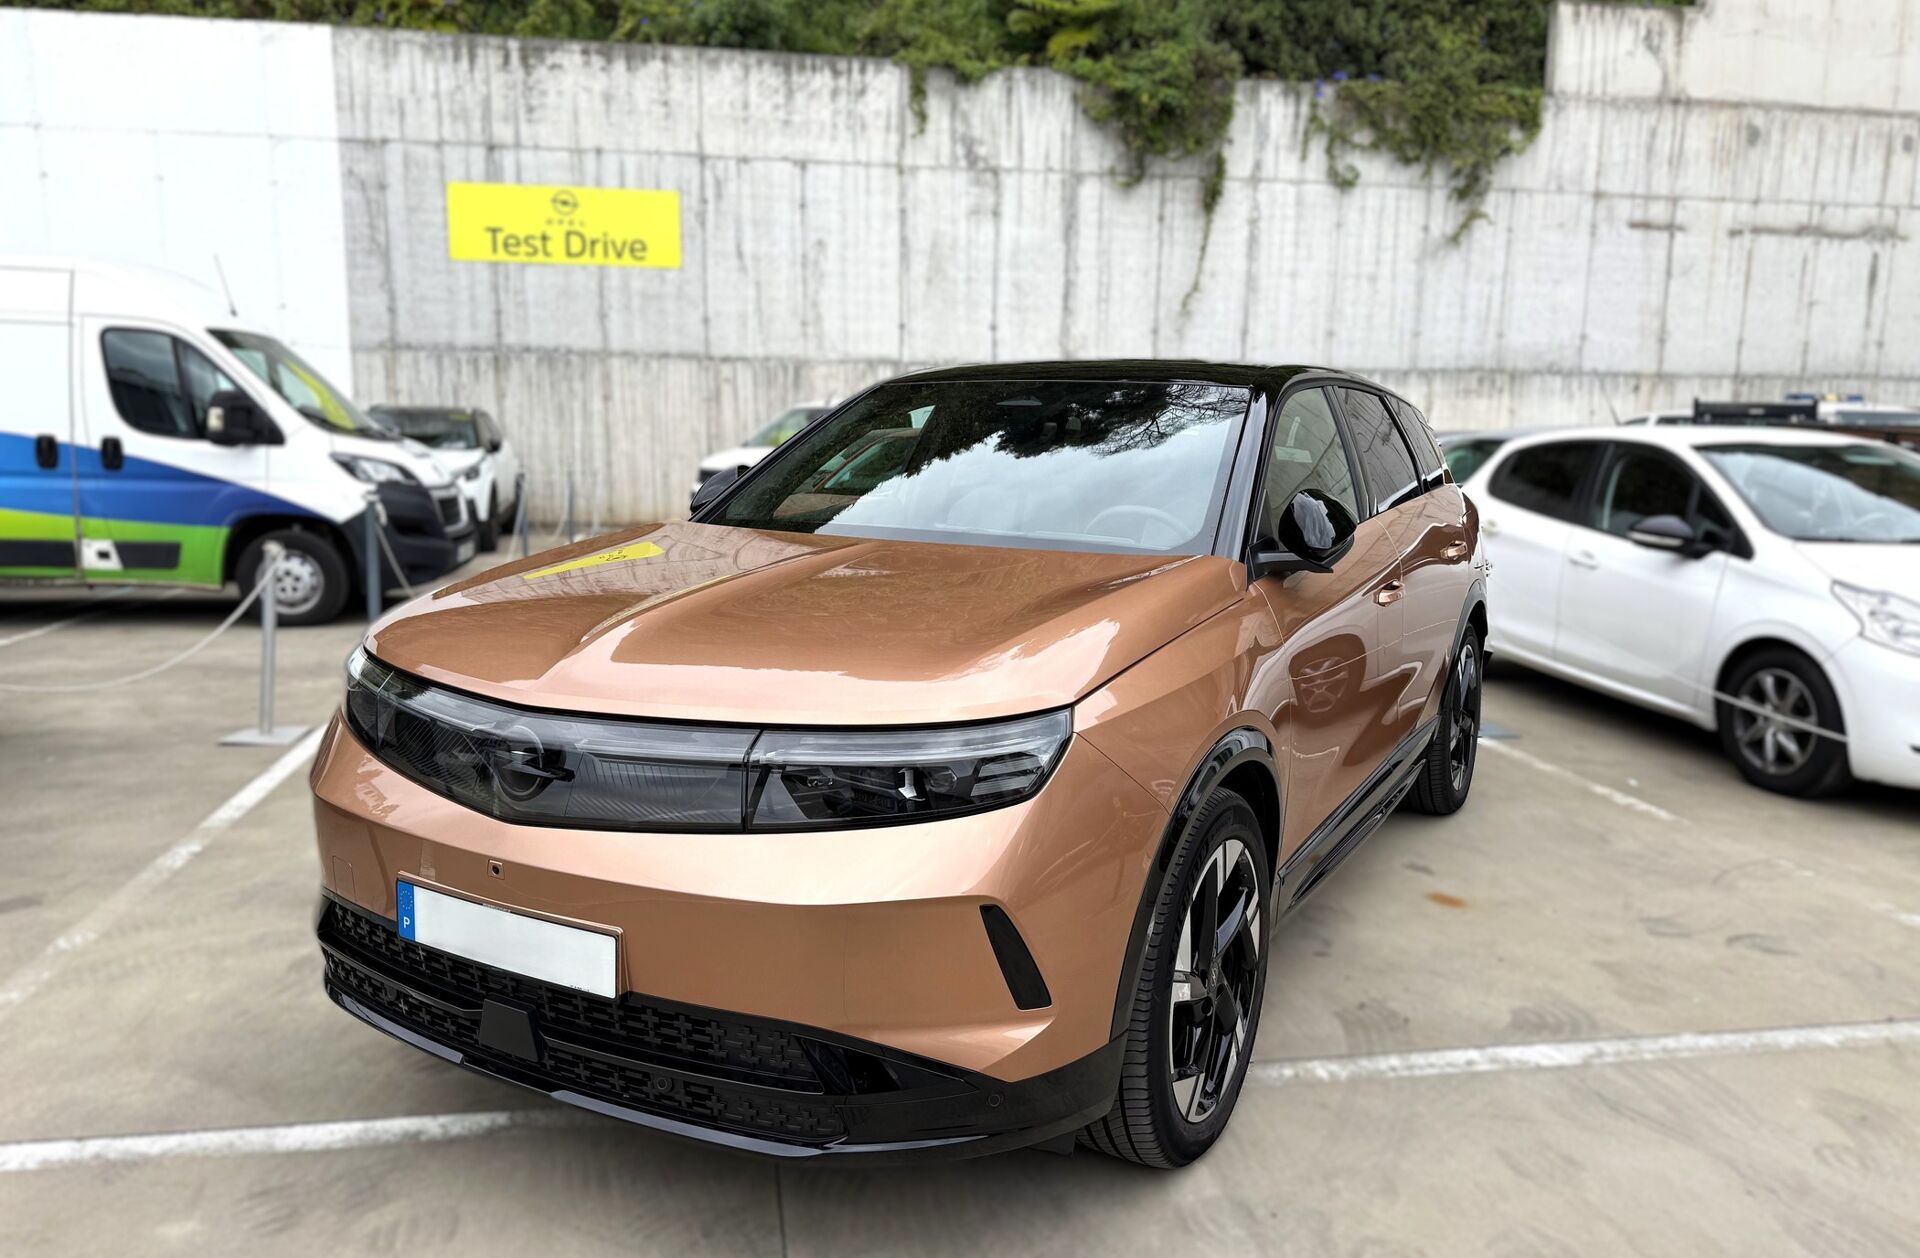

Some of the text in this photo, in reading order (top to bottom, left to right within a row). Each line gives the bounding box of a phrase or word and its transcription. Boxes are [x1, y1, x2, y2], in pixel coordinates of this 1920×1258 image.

[485, 226, 648, 261] Test Drive
[403, 916, 411, 929] P
